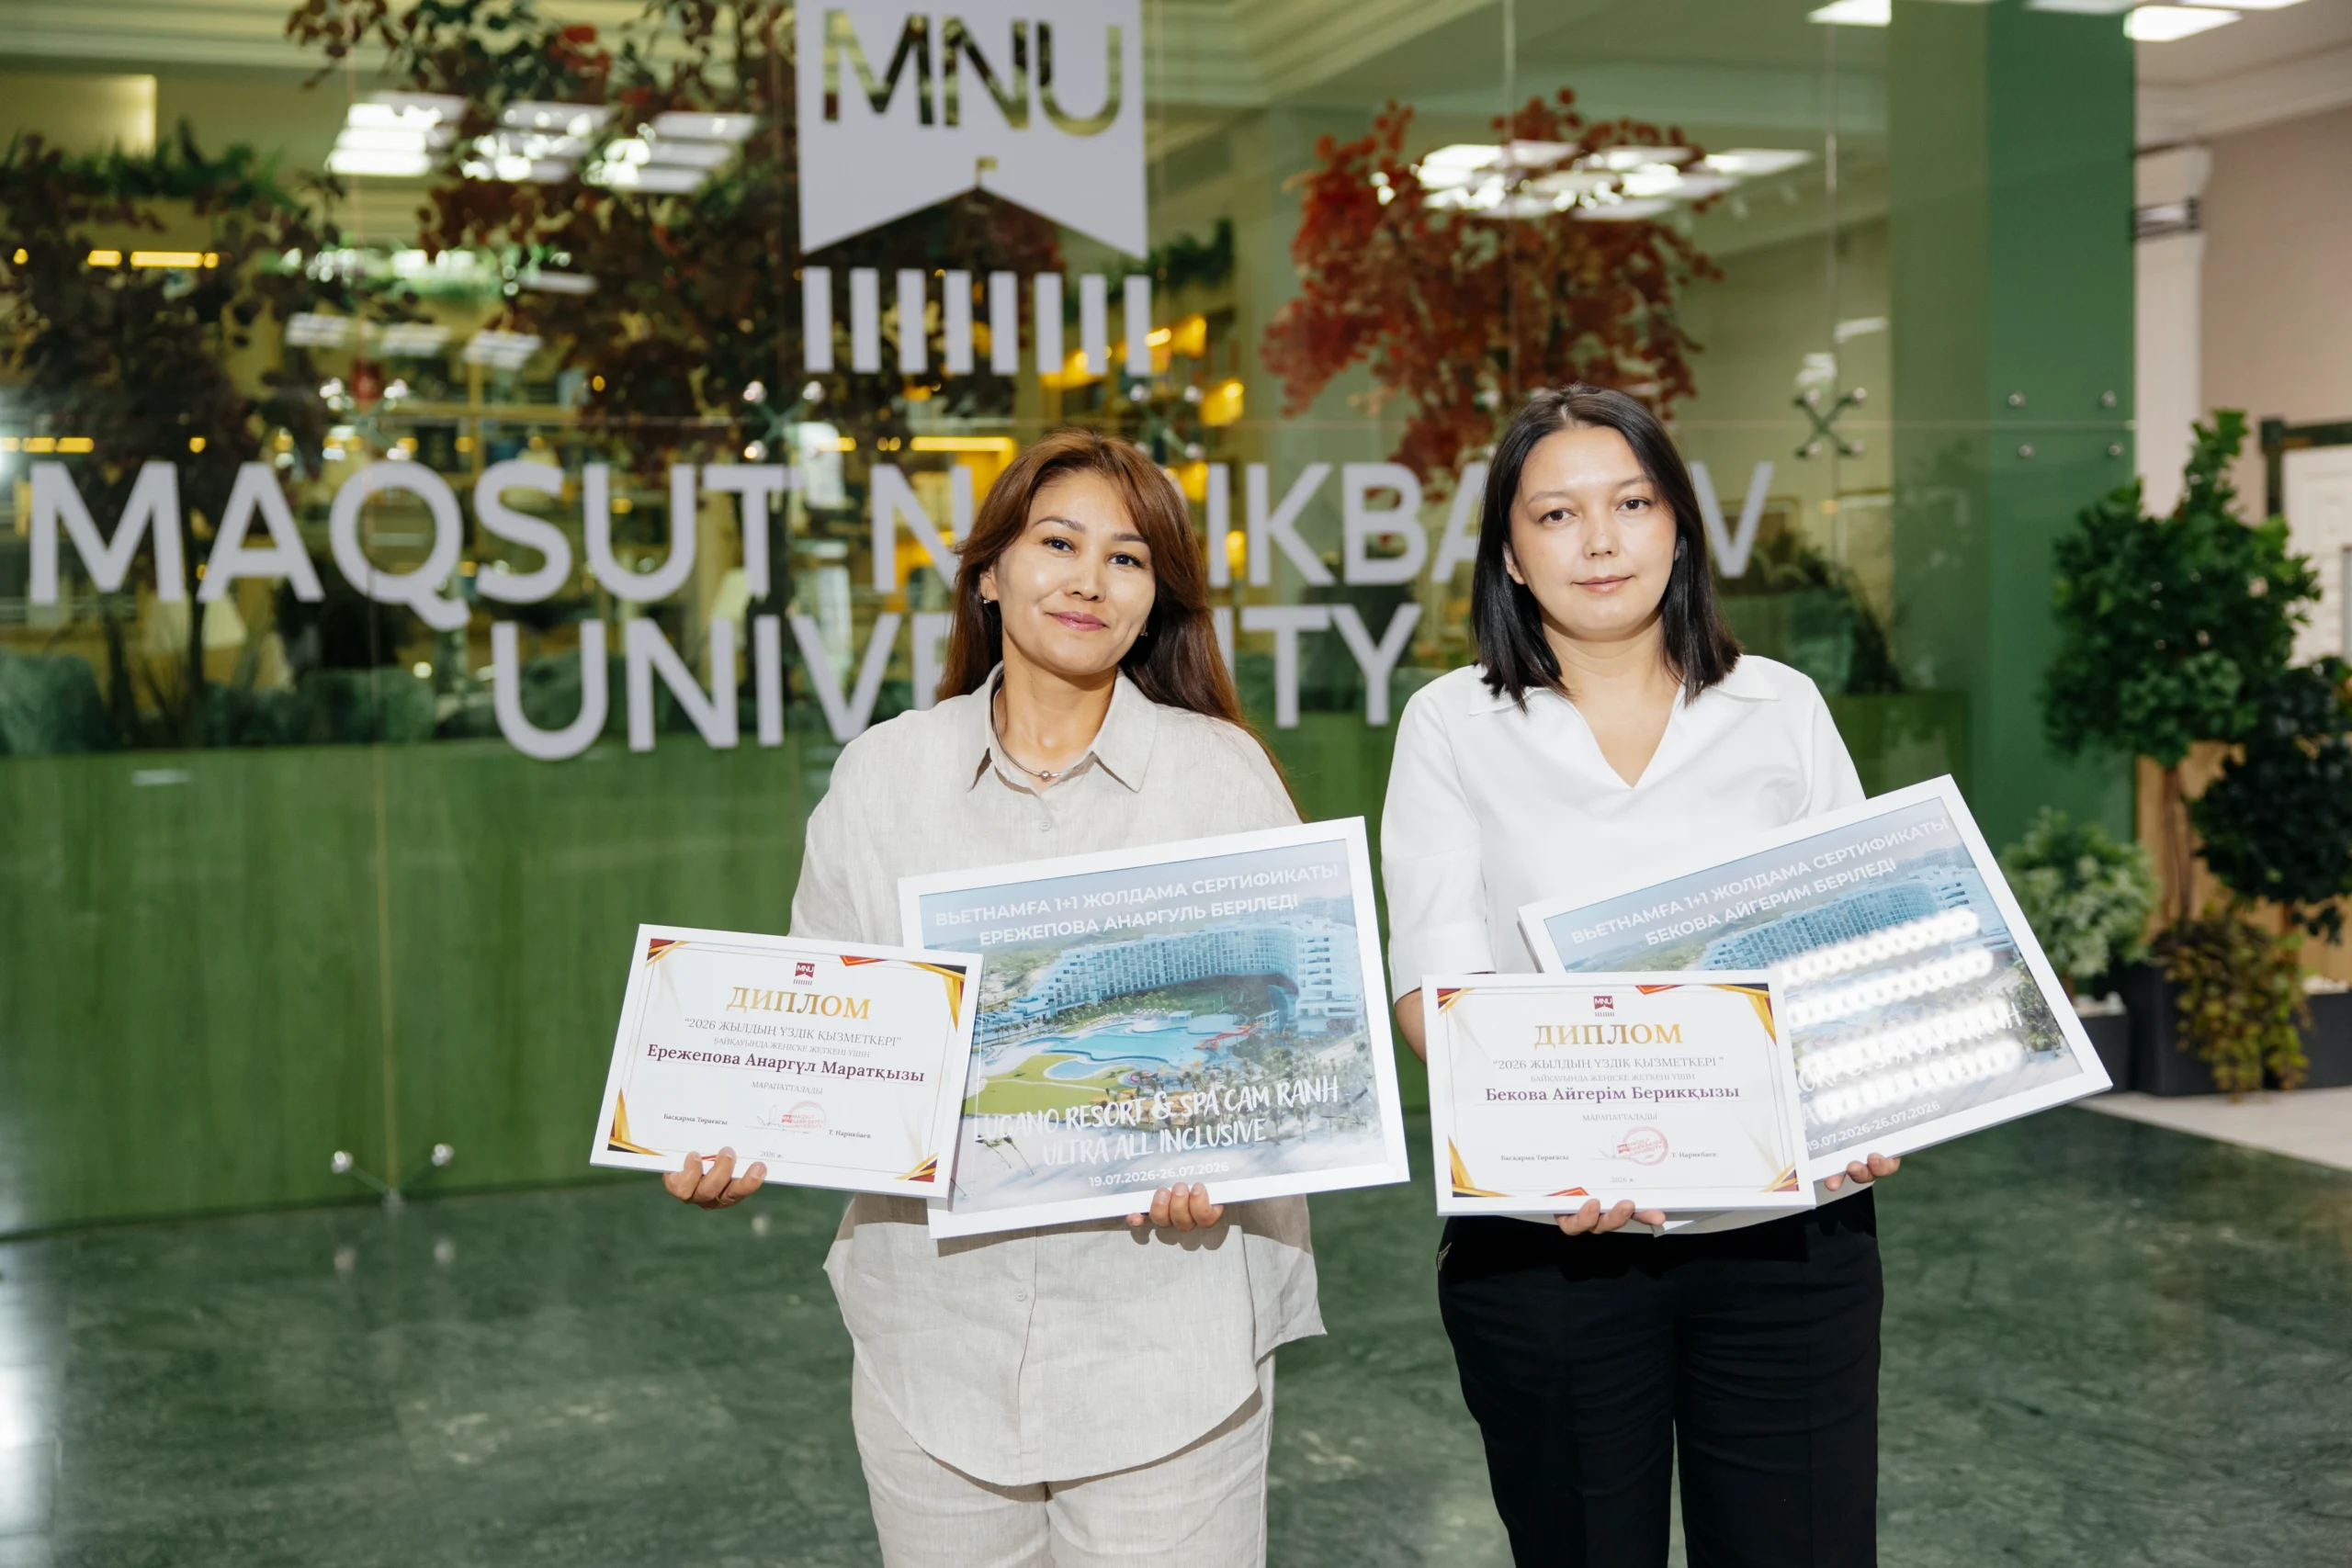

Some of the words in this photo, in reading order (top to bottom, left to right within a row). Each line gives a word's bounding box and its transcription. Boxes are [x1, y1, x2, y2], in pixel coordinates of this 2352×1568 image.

[822, 9, 1123, 137] MNU
[28, 459, 803, 632] MAQSUT
[871, 461, 1775, 595] NIKBAV
[492, 603, 1422, 761] UNIVEITY
[935, 899, 1051, 927] ВЬЕТНАМҒА
[1055, 895, 1079, 912] 1+1
[1082, 883, 1188, 908] ЖОЛДАМА
[1192, 863, 1339, 895] СЕРТИФИКАТЫ
[1571, 900, 1684, 945] ВЬЕТНАМҒА
[1684, 891, 1710, 909] 1+1
[1711, 861, 1812, 900] ЖОЛДАМА
[1813, 817, 1950, 869] СЕРТИФИКАТЫ
[1645, 914, 1722, 947] БЕКОВА
[1724, 883, 1812, 922] АЙГЕРИМ
[1814, 857, 1897, 894] БЕРІЛЕДІ
[979, 920, 1099, 946] ЕРЕЖЕПОВА
[1103, 906, 1206, 932] АНАРГУЛЬ
[1211, 893, 1299, 917] БЕРІЛЕДІ
[797, 964, 815, 973] MNU
[726, 986, 871, 1020] ДИПЛОМ
[718, 1021, 776, 1036] ЖЫЛДЫҢ
[780, 1027, 815, 1040] ҮЗДІК
[1533, 1023, 1683, 1050] ДИПЛОМ
[714, 1037, 768, 1049] БАЙҚАУЫНДА
[809, 1045, 846, 1056] ЖЕТКЕНІ
[647, 1043, 741, 1066] Ережепова
[745, 1053, 816, 1075] Анаргүл
[821, 1060, 925, 1082] Маратқызы
[1530, 1059, 1591, 1070] ЖЫЛДЫҢ
[1594, 1058, 1632, 1069] ҮЗДІК
[752, 1081, 823, 1095] МАРАПАТТАЛАДЫ
[1065, 1098, 1148, 1132] RESORT
[1151, 1090, 1177, 1121] &
[1179, 1085, 1220, 1118] SPA
[1224, 1085, 1271, 1113] CAM
[1276, 1074, 1339, 1109] RANH
[1486, 1088, 1547, 1101] Бекова
[1553, 1086, 1627, 1103] Айгерім
[1631, 1086, 1740, 1102] Берикқызы
[663, 1113, 695, 1122] Басқарма
[1582, 1113, 1658, 1122] МАРАПАТТАЛАДЫ
[835, 1130, 871, 1139] Нарикбаев
[1043, 1135, 1110, 1167] ULTRA
[1114, 1132, 1155, 1161] ALL
[1159, 1117, 1267, 1155] INCLUSIVE
[1089, 1161, 1229, 1188] 19.07.2026-26.07.2026
